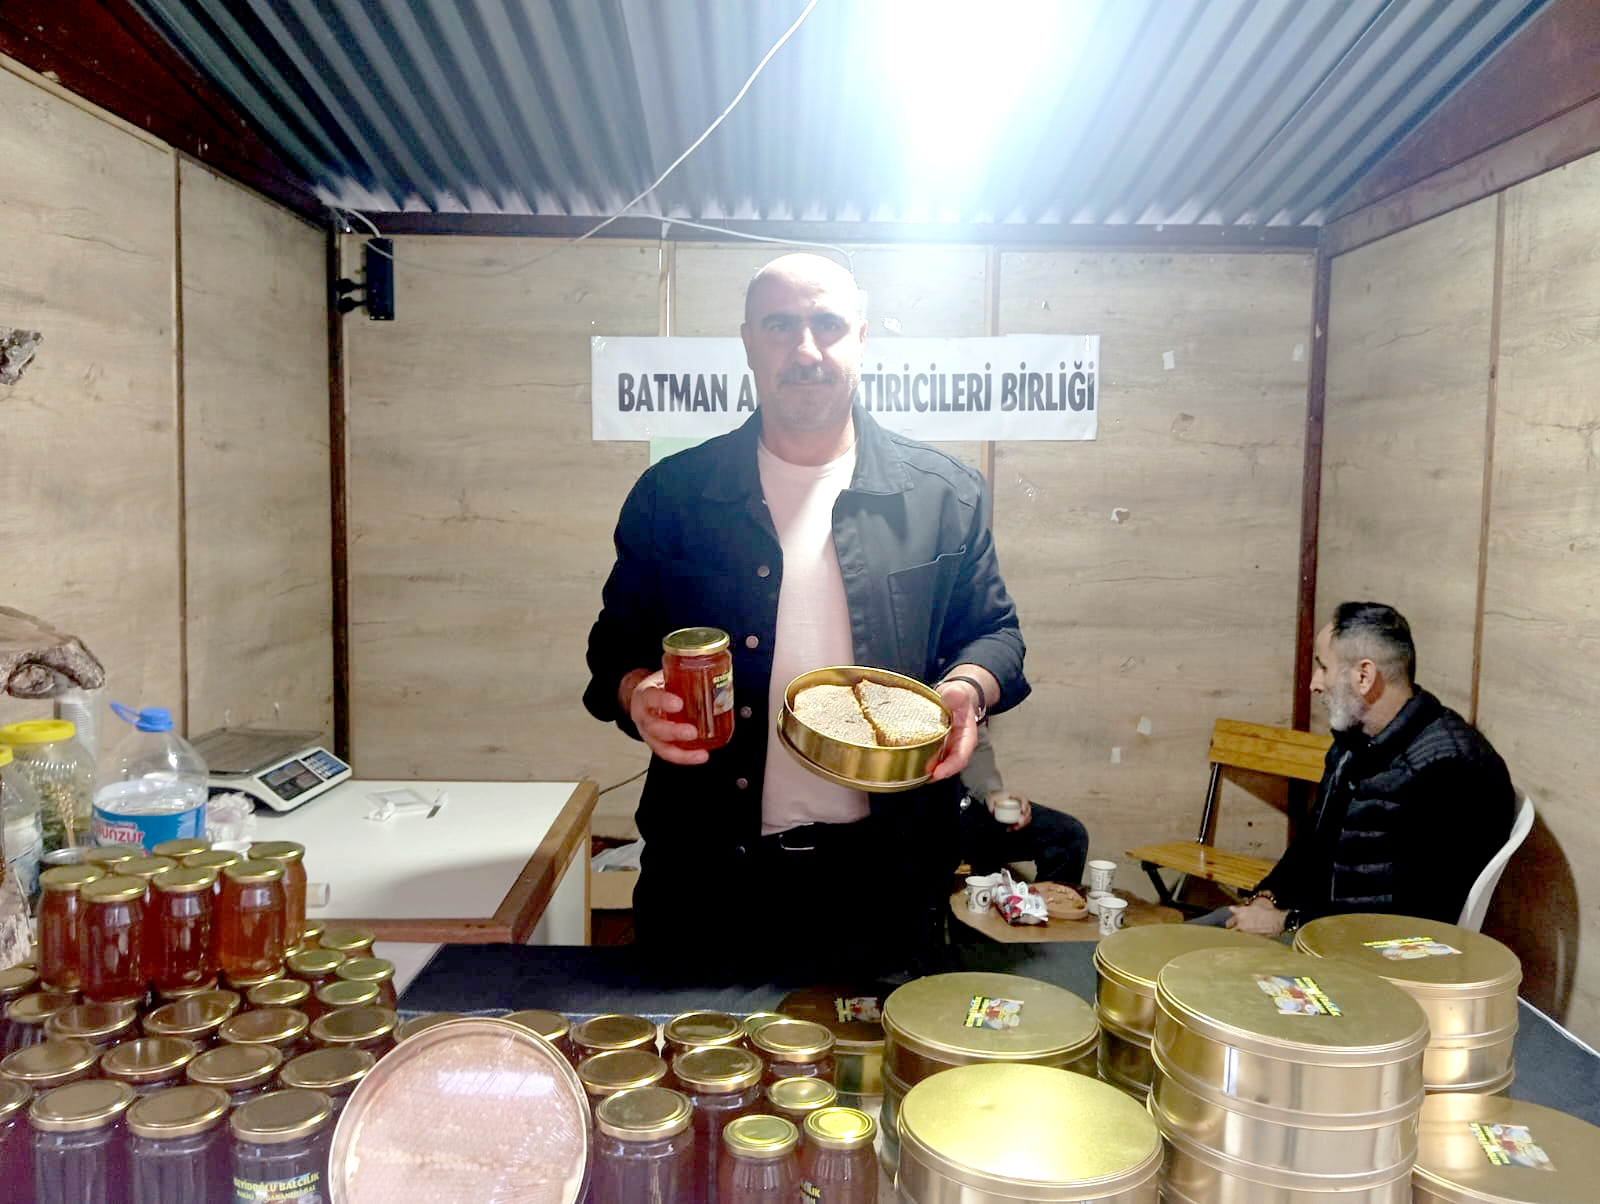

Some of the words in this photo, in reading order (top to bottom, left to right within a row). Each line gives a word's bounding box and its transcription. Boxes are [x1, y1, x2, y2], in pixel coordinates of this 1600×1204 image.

[618, 373, 728, 412] BATMAN
[737, 374, 757, 412] A
[860, 362, 992, 413] TİRİCİLERİ
[1001, 360, 1095, 412] BİRLİĞİ
